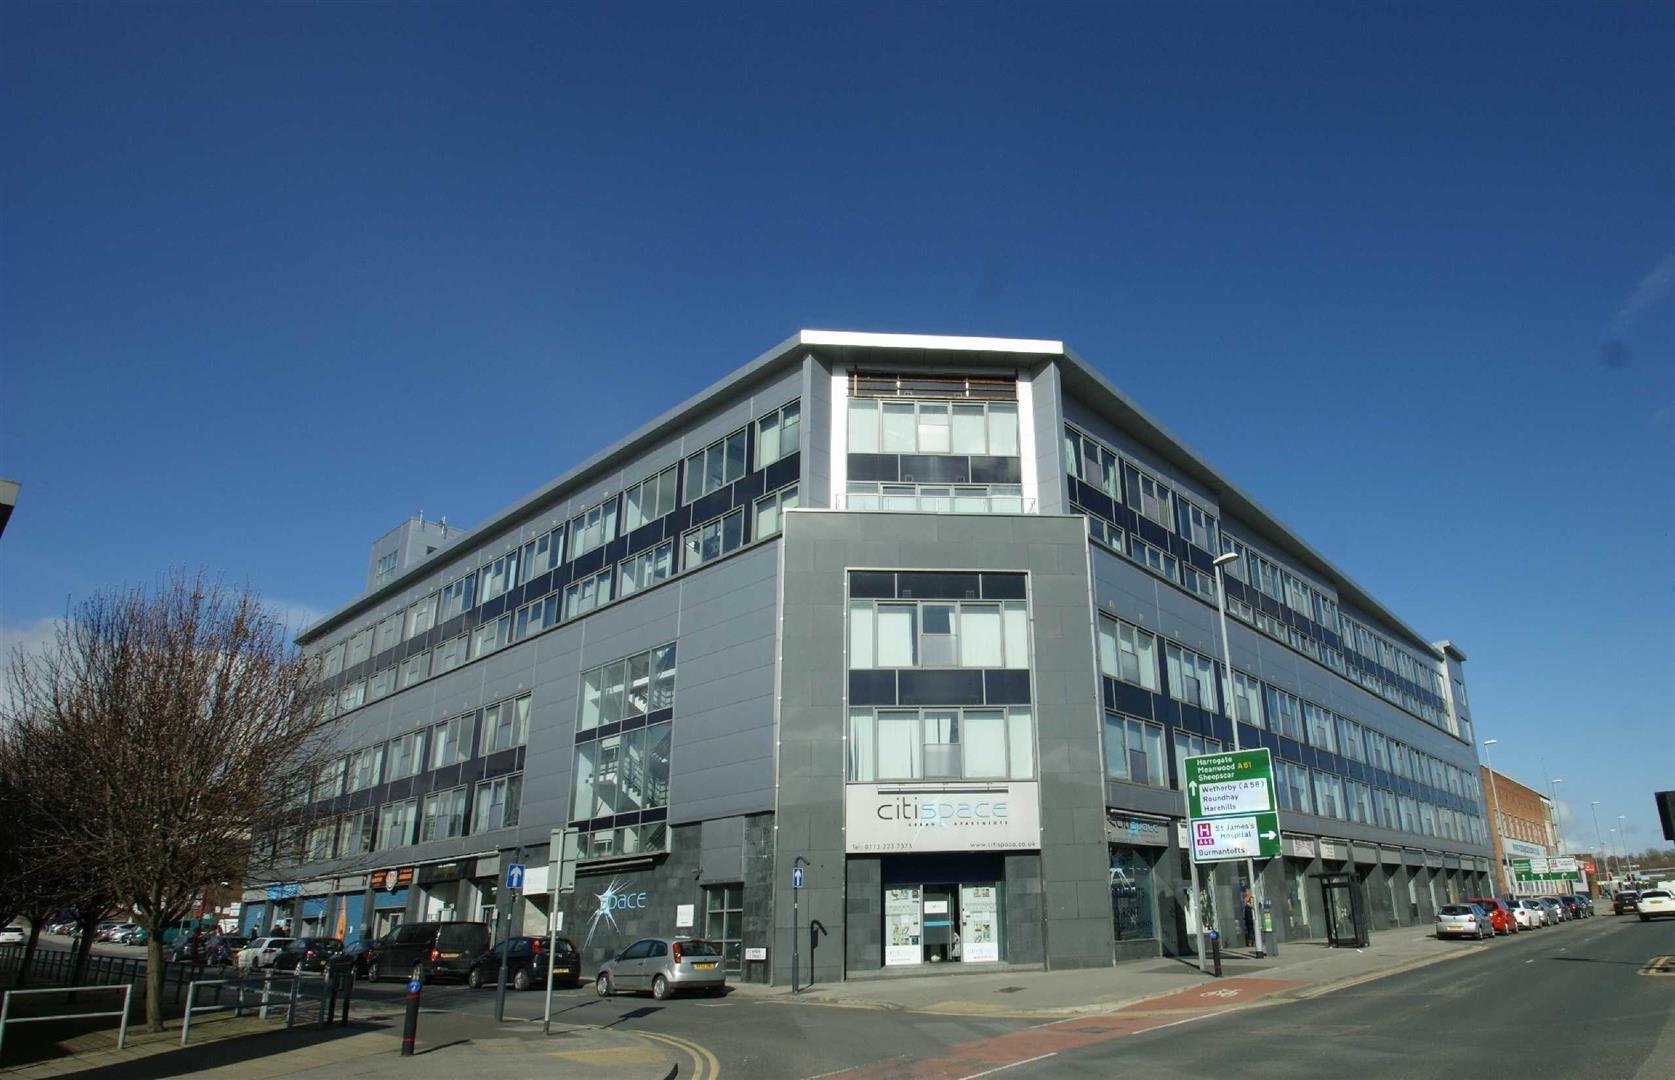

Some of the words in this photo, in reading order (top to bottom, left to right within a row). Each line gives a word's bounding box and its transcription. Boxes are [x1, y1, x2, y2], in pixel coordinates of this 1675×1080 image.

[1197, 756, 1233, 766] Harrogate
[1197, 763, 1236, 774] Meanwood
[1198, 772, 1234, 781] Sheepscar
[1202, 784, 1236, 793] Wetherby
[1203, 794, 1239, 802] Roundhay
[878, 797, 1008, 825] citispace
[1221, 831, 1252, 839] Hospital
[1199, 848, 1245, 856] Burmantofts
